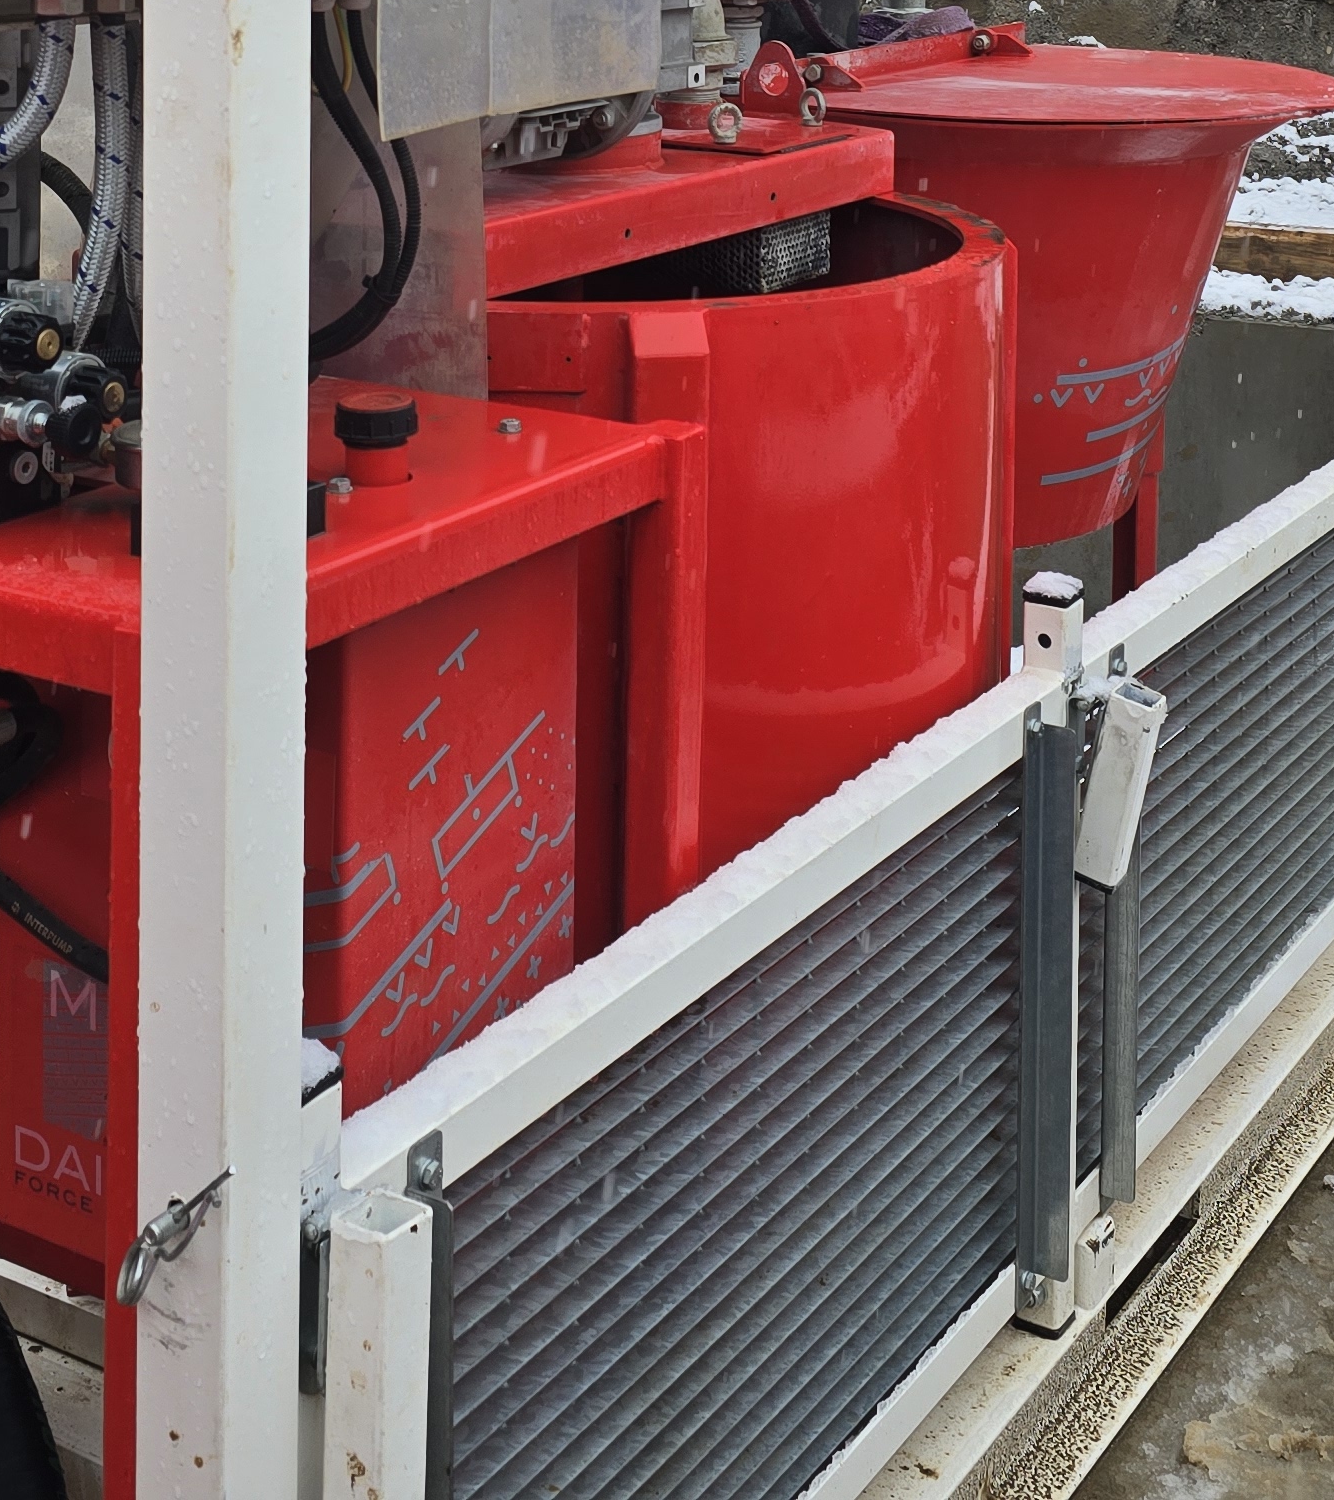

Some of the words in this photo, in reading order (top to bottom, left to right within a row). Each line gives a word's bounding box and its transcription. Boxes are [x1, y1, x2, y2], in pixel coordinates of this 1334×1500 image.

[24, 912, 73, 954] INTERPUMP
[15, 1125, 101, 1196] DAI
[14, 1170, 93, 1213] FORCE
